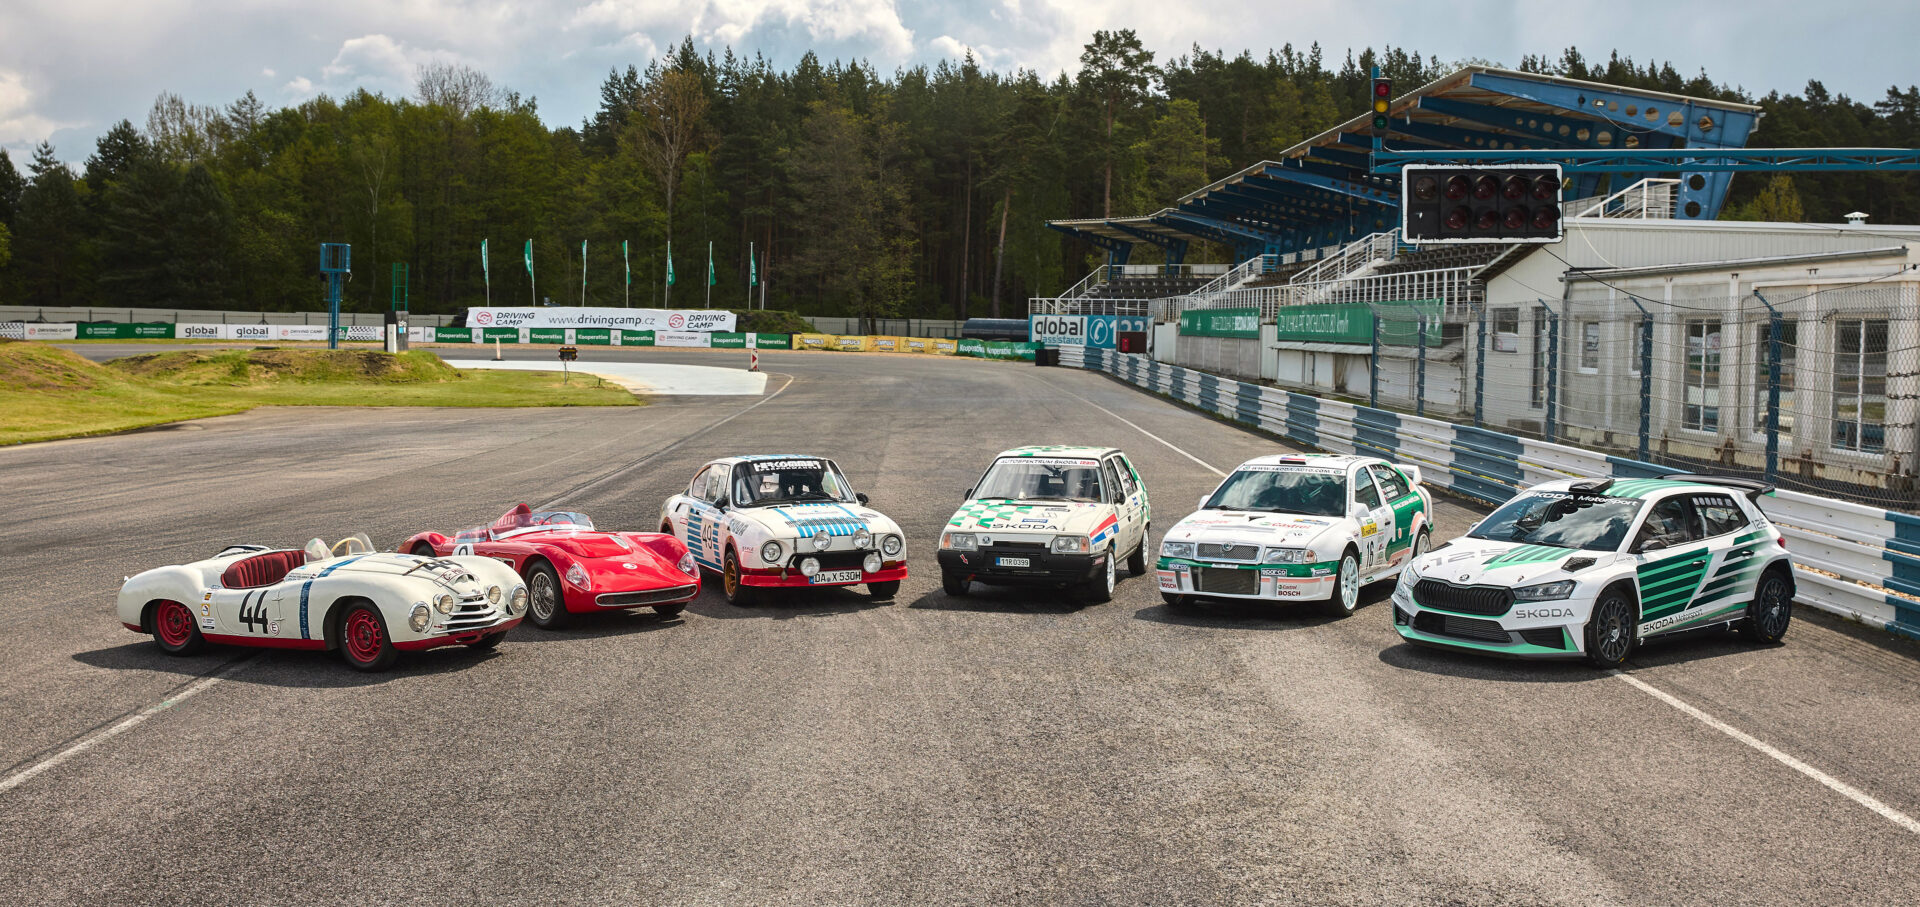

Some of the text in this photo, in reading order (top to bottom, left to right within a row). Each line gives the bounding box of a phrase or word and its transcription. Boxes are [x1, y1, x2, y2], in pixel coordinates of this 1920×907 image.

[496, 312, 536, 320] DRIVING
[548, 313, 656, 327] www.drivingcamp.cz
[688, 314, 727, 322] DRIVING
[687, 321, 714, 329] CAMP
[1035, 317, 1084, 337] global
[185, 326, 218, 338] global
[236, 327, 269, 338] global
[1042, 335, 1083, 344] assistance
[1577, 495, 1640, 506] Motorsport
[701, 524, 713, 550] 49
[1001, 558, 1013, 566] 11R
[814, 571, 861, 582] DA X 530H
[239, 590, 269, 635] 44
